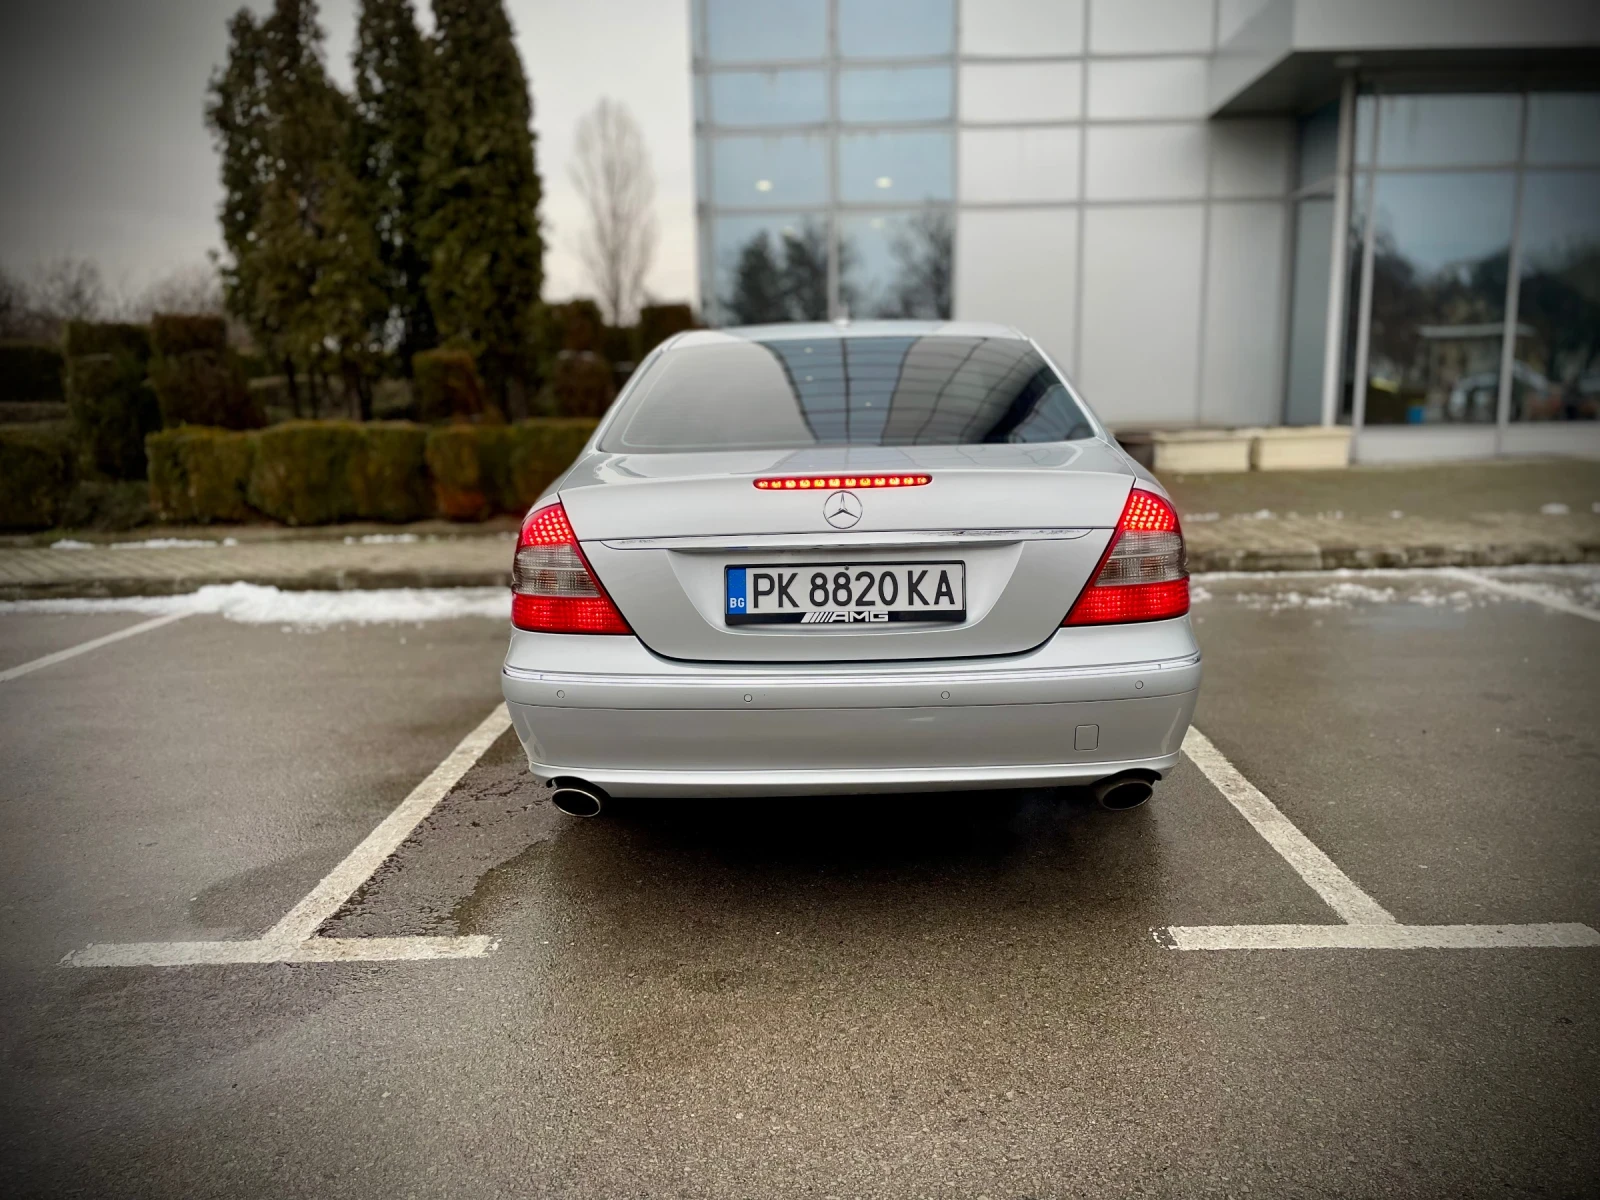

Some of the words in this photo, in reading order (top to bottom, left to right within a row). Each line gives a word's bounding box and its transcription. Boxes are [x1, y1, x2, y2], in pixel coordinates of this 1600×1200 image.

[753, 573, 800, 608] PK
[809, 571, 899, 607] 8820
[907, 570, 956, 605] KA
[730, 597, 745, 608] BG
[831, 611, 889, 623] AMG
